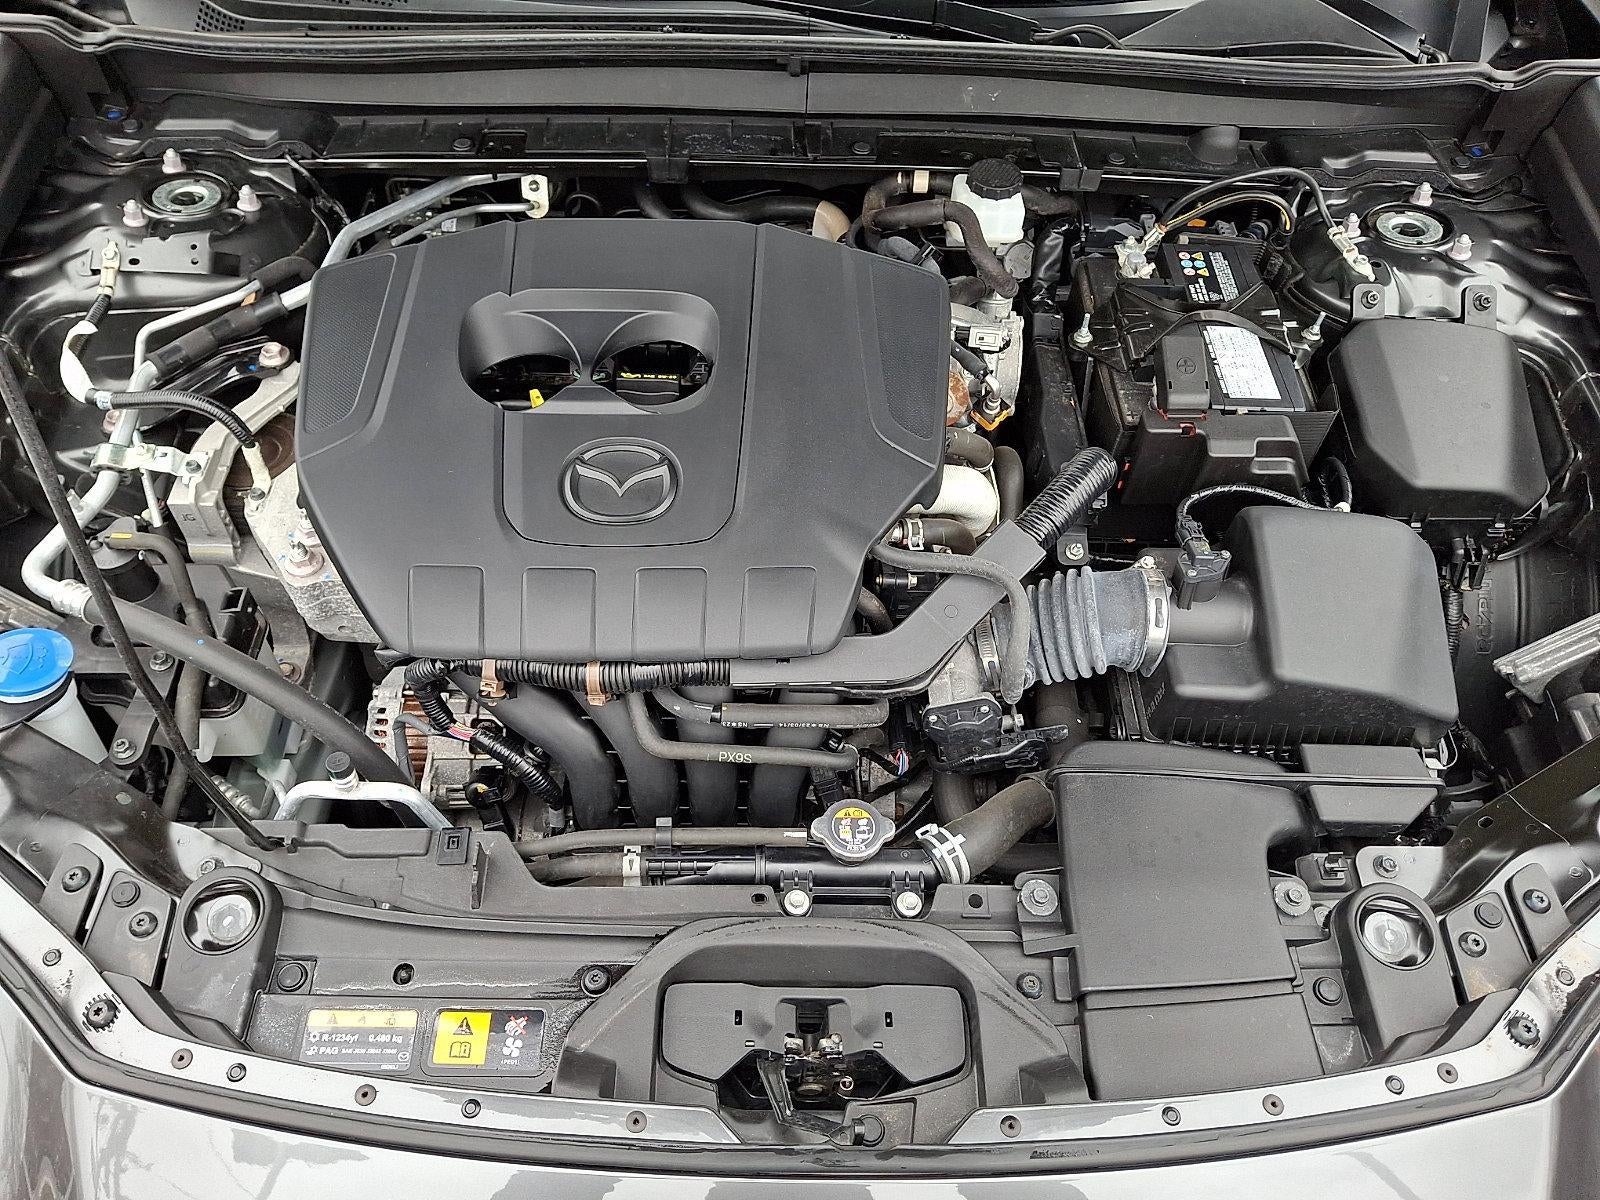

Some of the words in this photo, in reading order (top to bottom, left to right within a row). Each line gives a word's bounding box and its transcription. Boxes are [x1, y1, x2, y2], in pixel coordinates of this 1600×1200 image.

[718, 751, 752, 764] PX9S
[321, 1033, 360, 1043] R-1234yf
[391, 1034, 403, 1044] kg
[319, 1046, 339, 1055] PAG
